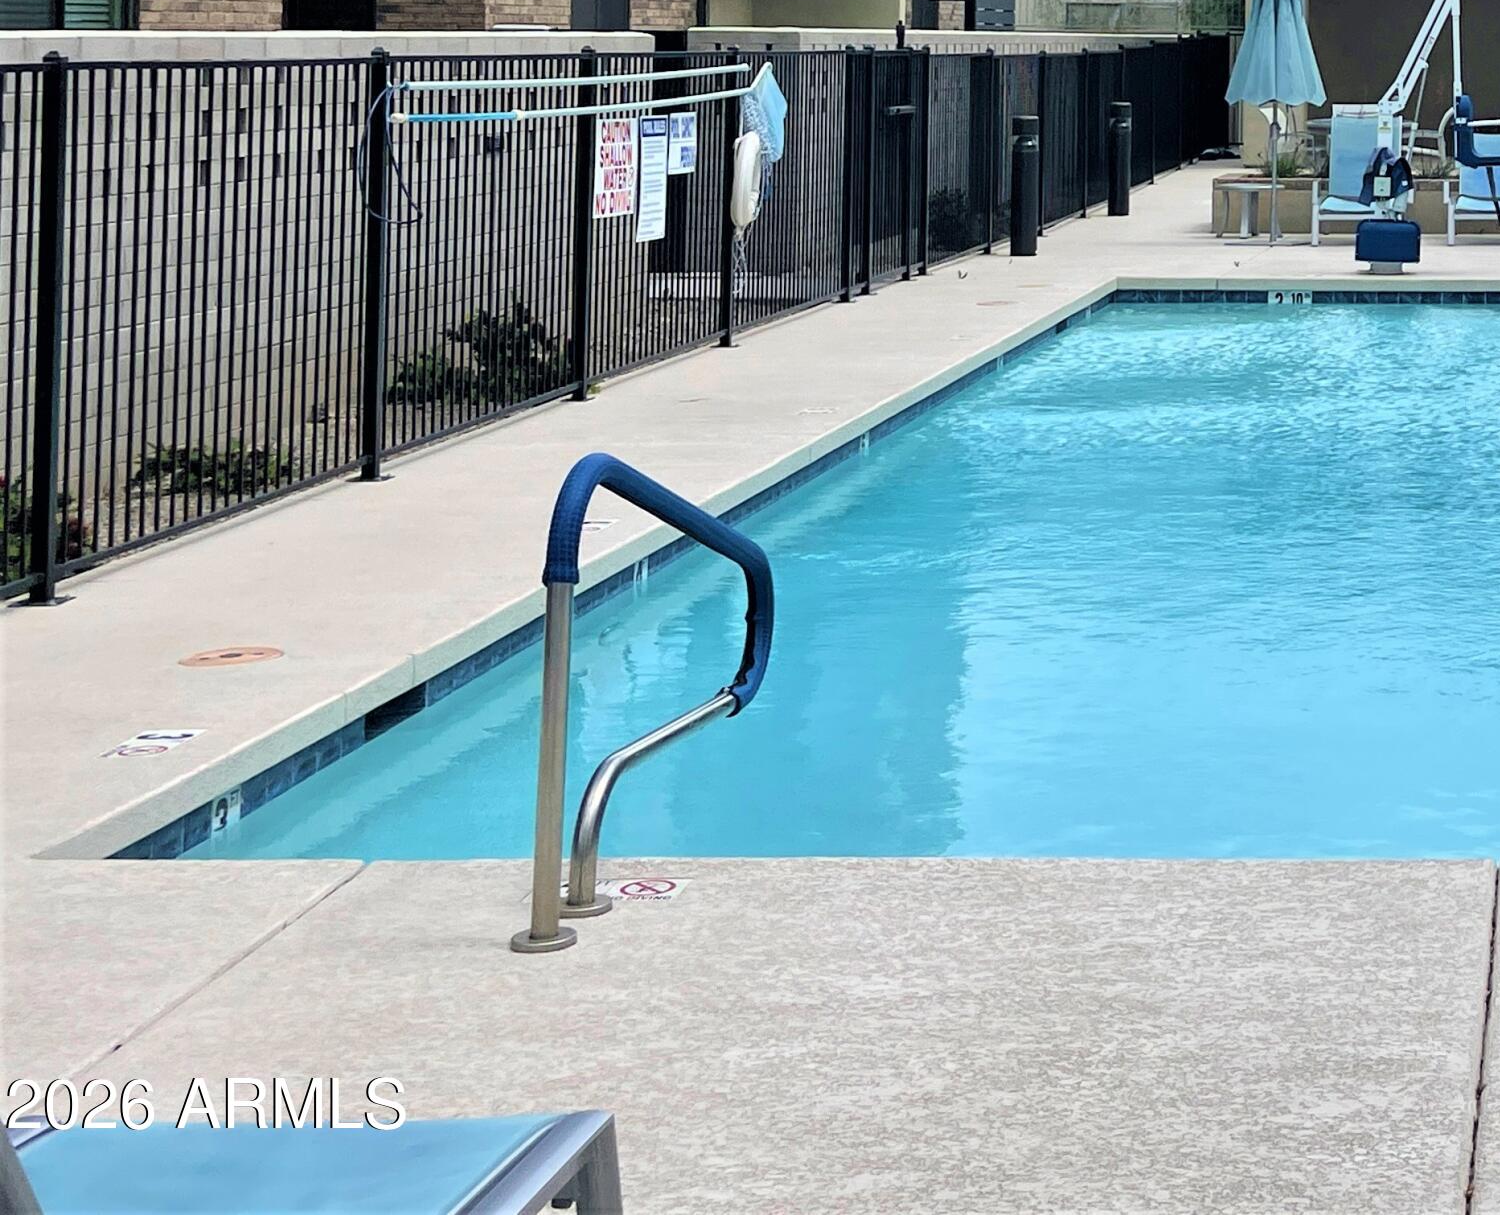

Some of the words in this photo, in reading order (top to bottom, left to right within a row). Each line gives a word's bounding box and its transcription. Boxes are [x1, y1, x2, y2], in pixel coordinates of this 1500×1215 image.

[601, 120, 632, 144] CAUTION
[600, 144, 633, 168] SHALLOW
[603, 168, 628, 191] WATER
[595, 192, 607, 216] NO
[609, 190, 632, 214] DIVING
[1291, 292, 1303, 304] 10
[213, 797, 228, 832] 3
